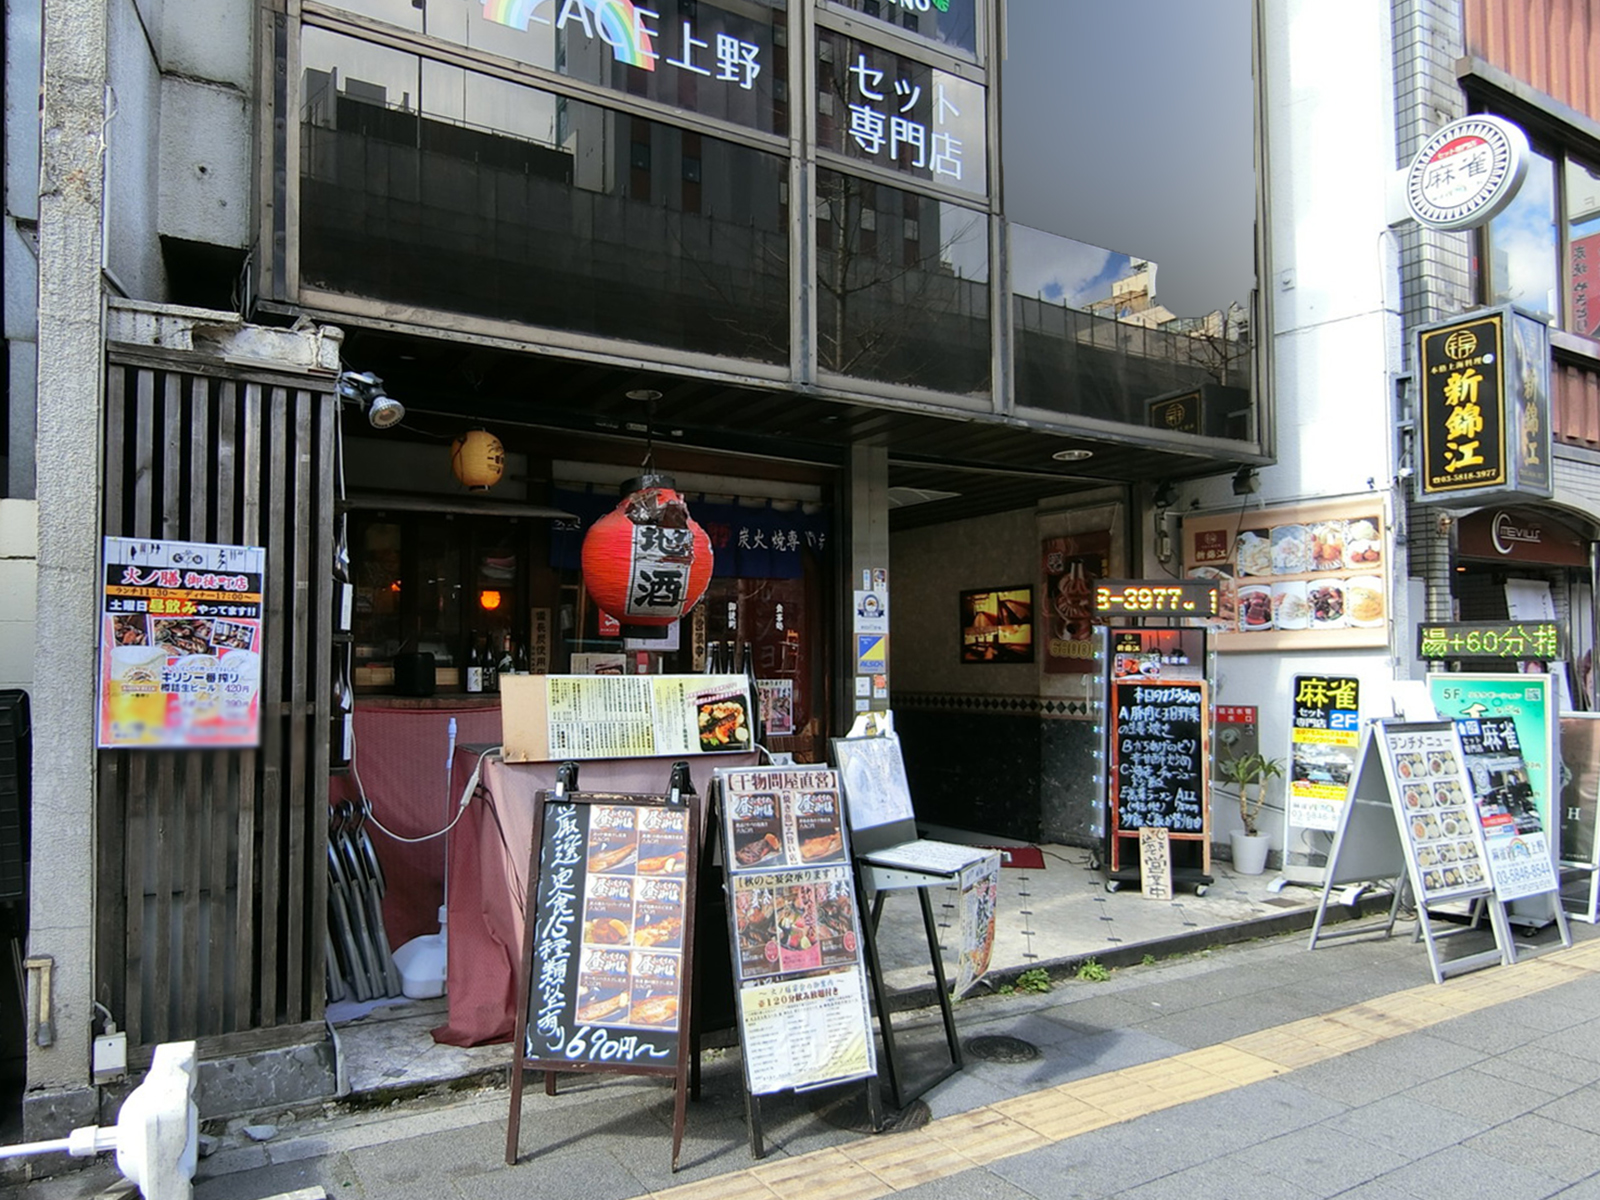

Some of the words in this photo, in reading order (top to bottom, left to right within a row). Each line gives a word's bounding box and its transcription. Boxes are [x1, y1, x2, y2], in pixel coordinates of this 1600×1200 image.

[849, 54, 960, 124] セット
[848, 105, 962, 180] 専門店
[1425, 152, 1488, 189] 麻雀
[1444, 368, 1484, 472] 新錦江
[122, 566, 182, 587] 火ノ膳
[185, 572, 250, 591] 御徒町店
[634, 527, 688, 607] 地酒
[161, 671, 240, 684] キリン一番搾り
[1295, 678, 1357, 709] 麻雀
[1443, 688, 1461, 700] 5F
[1299, 707, 1325, 718] セット
[1331, 713, 1356, 729] 2F
[1390, 735, 1452, 751] ランチメニュー
[1481, 720, 1520, 752] 麻雀
[728, 771, 837, 790] 【干物問屋直営】
[564, 1026, 671, 1061] 690円〜
